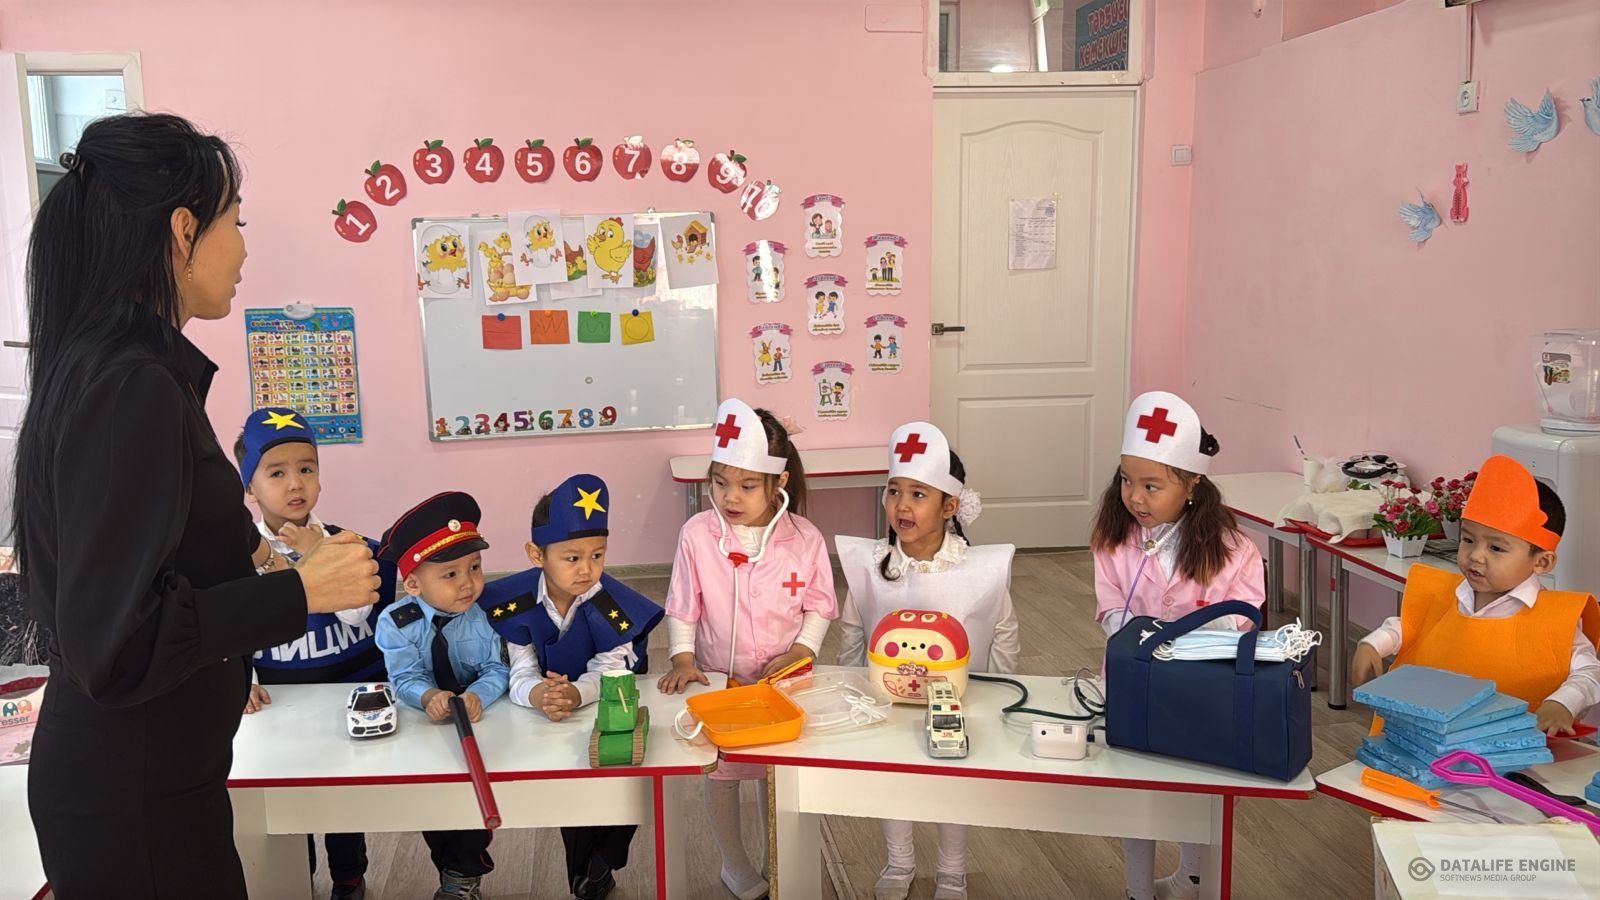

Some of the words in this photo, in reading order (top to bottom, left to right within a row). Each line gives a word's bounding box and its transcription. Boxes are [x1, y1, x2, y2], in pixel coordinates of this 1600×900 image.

[345, 212, 371, 237] 1
[375, 174, 400, 200] 2
[424, 153, 443, 178] 3
[474, 152, 494, 176] 4
[525, 152, 544, 177] 5
[574, 150, 592, 175] 6
[623, 149, 641, 173] 7
[670, 152, 687, 175] 8
[715, 164, 736, 185] 9
[435, 417, 448, 436] 1
[455, 415, 472, 435] 2
[475, 413, 491, 434] 3
[493, 412, 510, 432] 4
[513, 411, 530, 431] 5
[538, 410, 554, 430] 6
[557, 409, 574, 428] 7
[578, 408, 594, 428] 8
[601, 405, 617, 426] 9
[0, 715, 30, 726] esser
